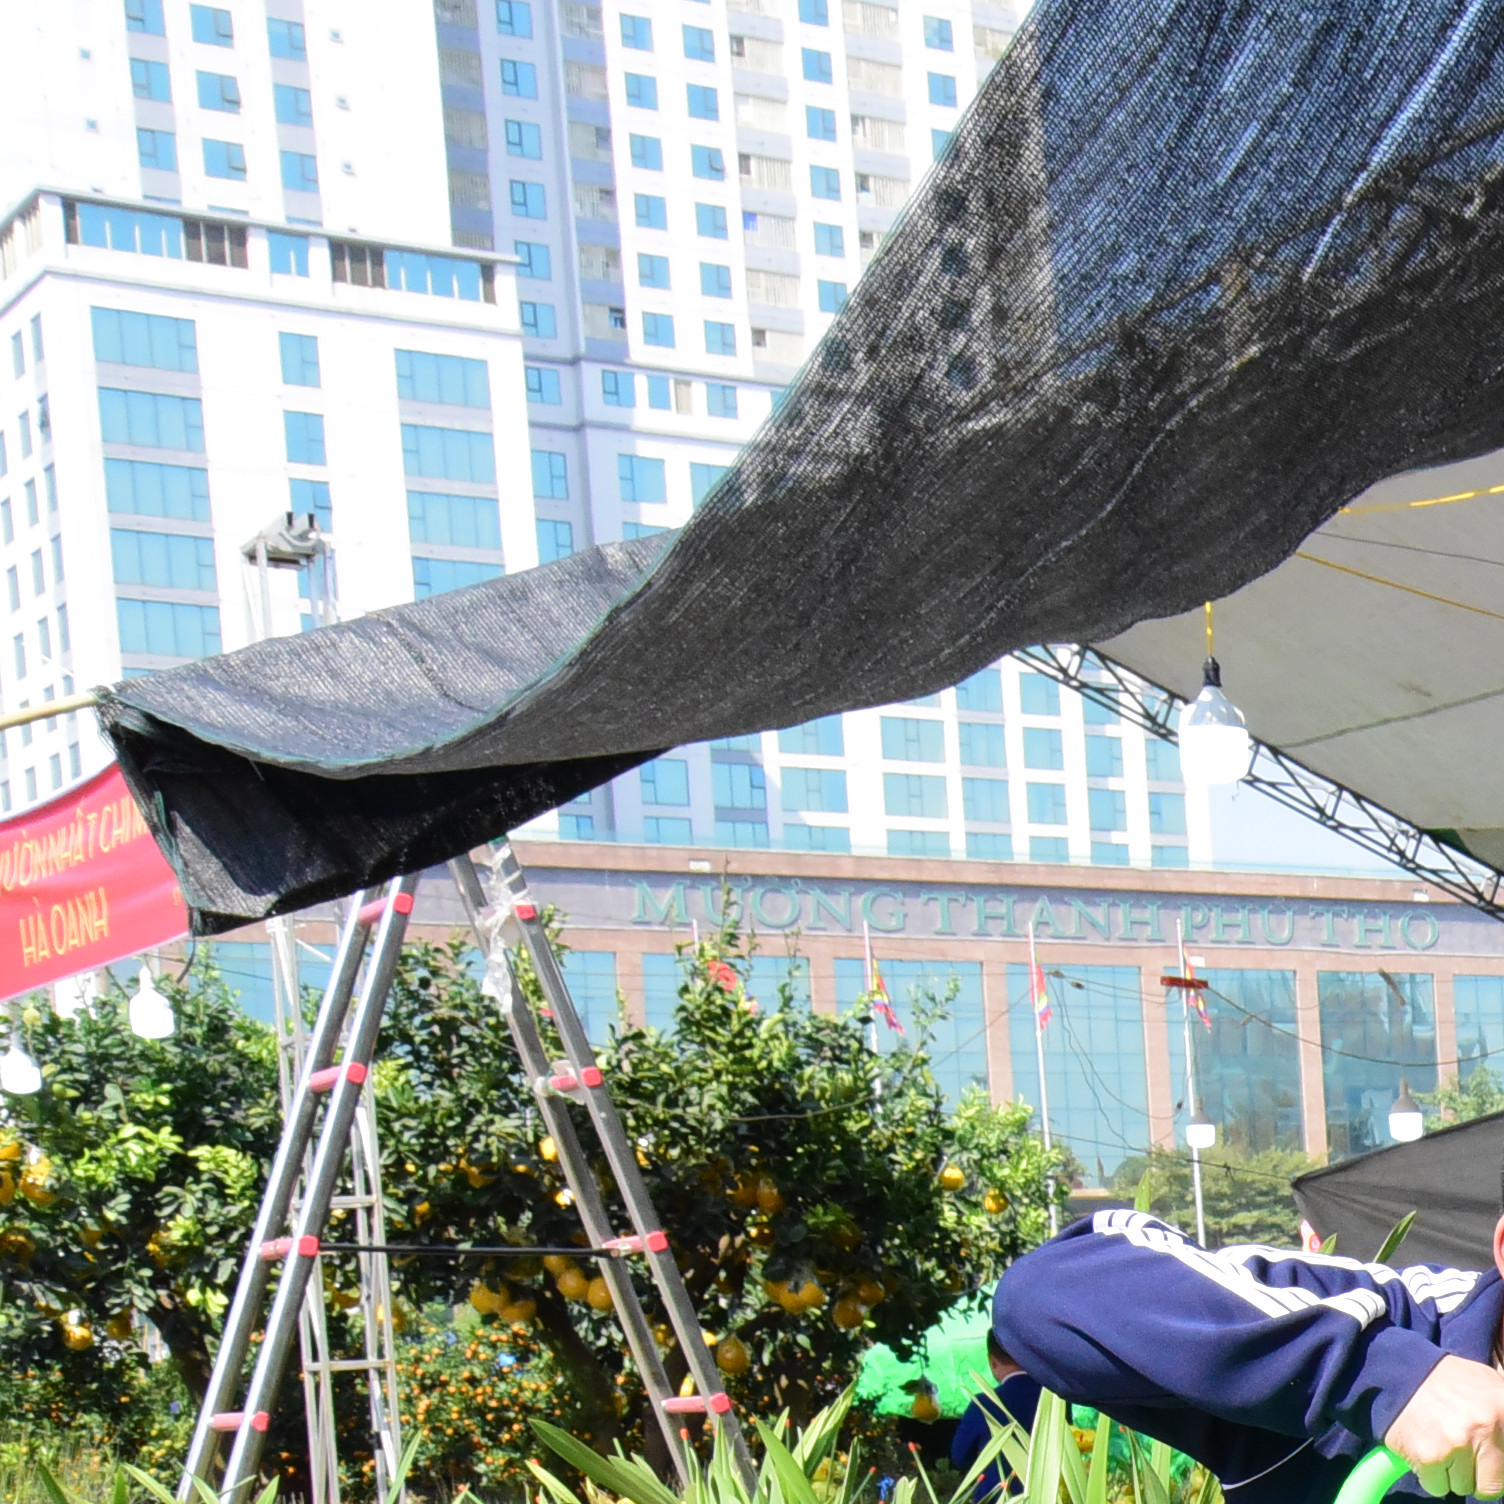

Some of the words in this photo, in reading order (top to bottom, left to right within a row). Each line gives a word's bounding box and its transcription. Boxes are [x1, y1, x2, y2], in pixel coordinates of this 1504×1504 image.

[19, 896, 52, 967] HÀ
[51, 887, 109, 955] OANH
[629, 874, 909, 933] MƯỜNG
[920, 889, 1166, 942] THANH
